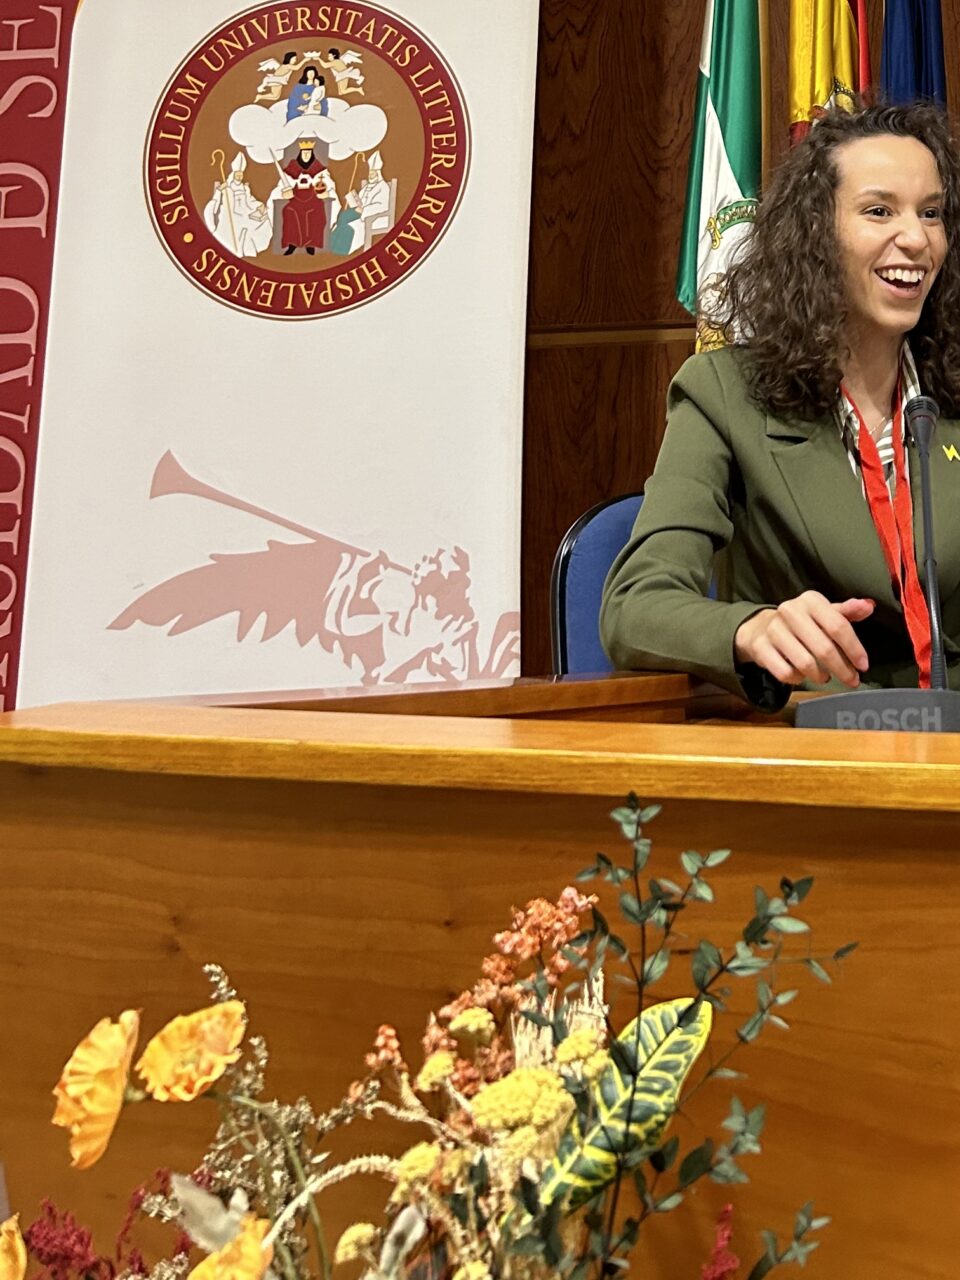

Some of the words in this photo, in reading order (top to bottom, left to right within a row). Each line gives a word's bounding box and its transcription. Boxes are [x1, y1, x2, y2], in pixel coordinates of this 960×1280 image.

[199, 6, 420, 72] UNIVERSITATIS
[156, 72, 208, 226] SIGILLUM
[385, 62, 457, 266] LITTERARIAE
[719, 204, 757, 225] DOMINA
[192, 248, 388, 309] HISPALENSIS
[836, 706, 942, 731] BOSCH
